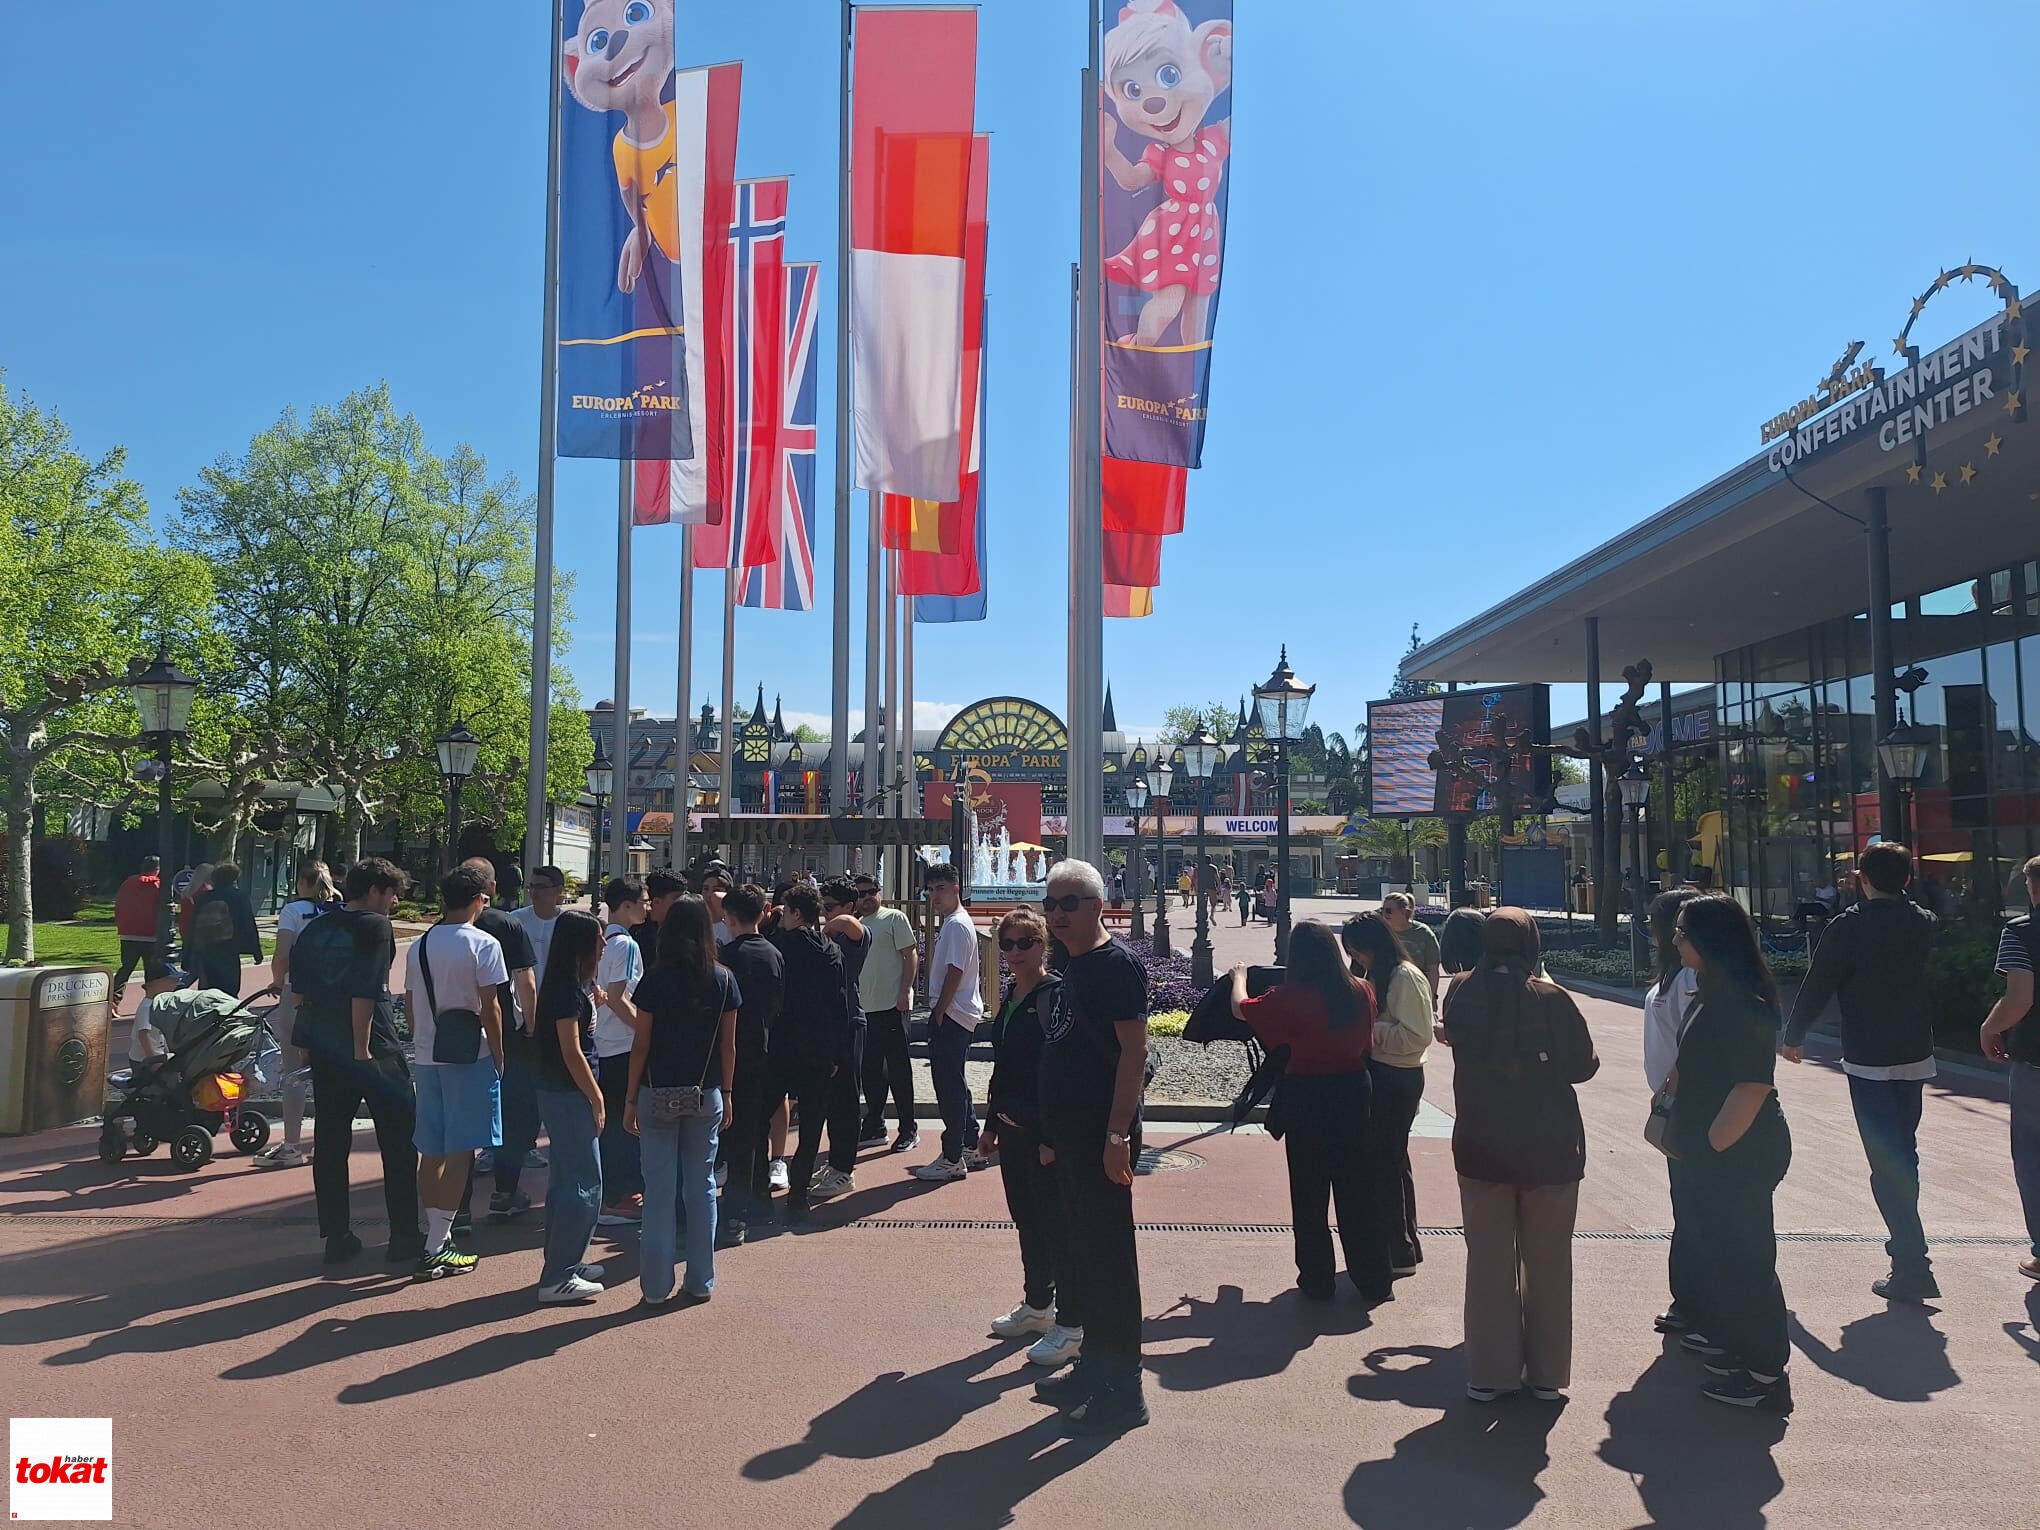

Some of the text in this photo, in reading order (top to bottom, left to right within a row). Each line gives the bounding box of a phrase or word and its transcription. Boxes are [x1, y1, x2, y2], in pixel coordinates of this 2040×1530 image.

[1829, 356, 1877, 404] PARK
[572, 394, 681, 411] EUROPA PARK
[1117, 395, 1169, 416] EUROPA
[1767, 319, 2005, 473] CONFERTAINMENT
[1878, 367, 1995, 452] CENTER
[951, 754, 1061, 768] EROPA PARK
[703, 819, 951, 845] EUROPA PARK
[1226, 820, 1279, 833] WELCOM
[48, 978, 104, 993] DRUCKEN
